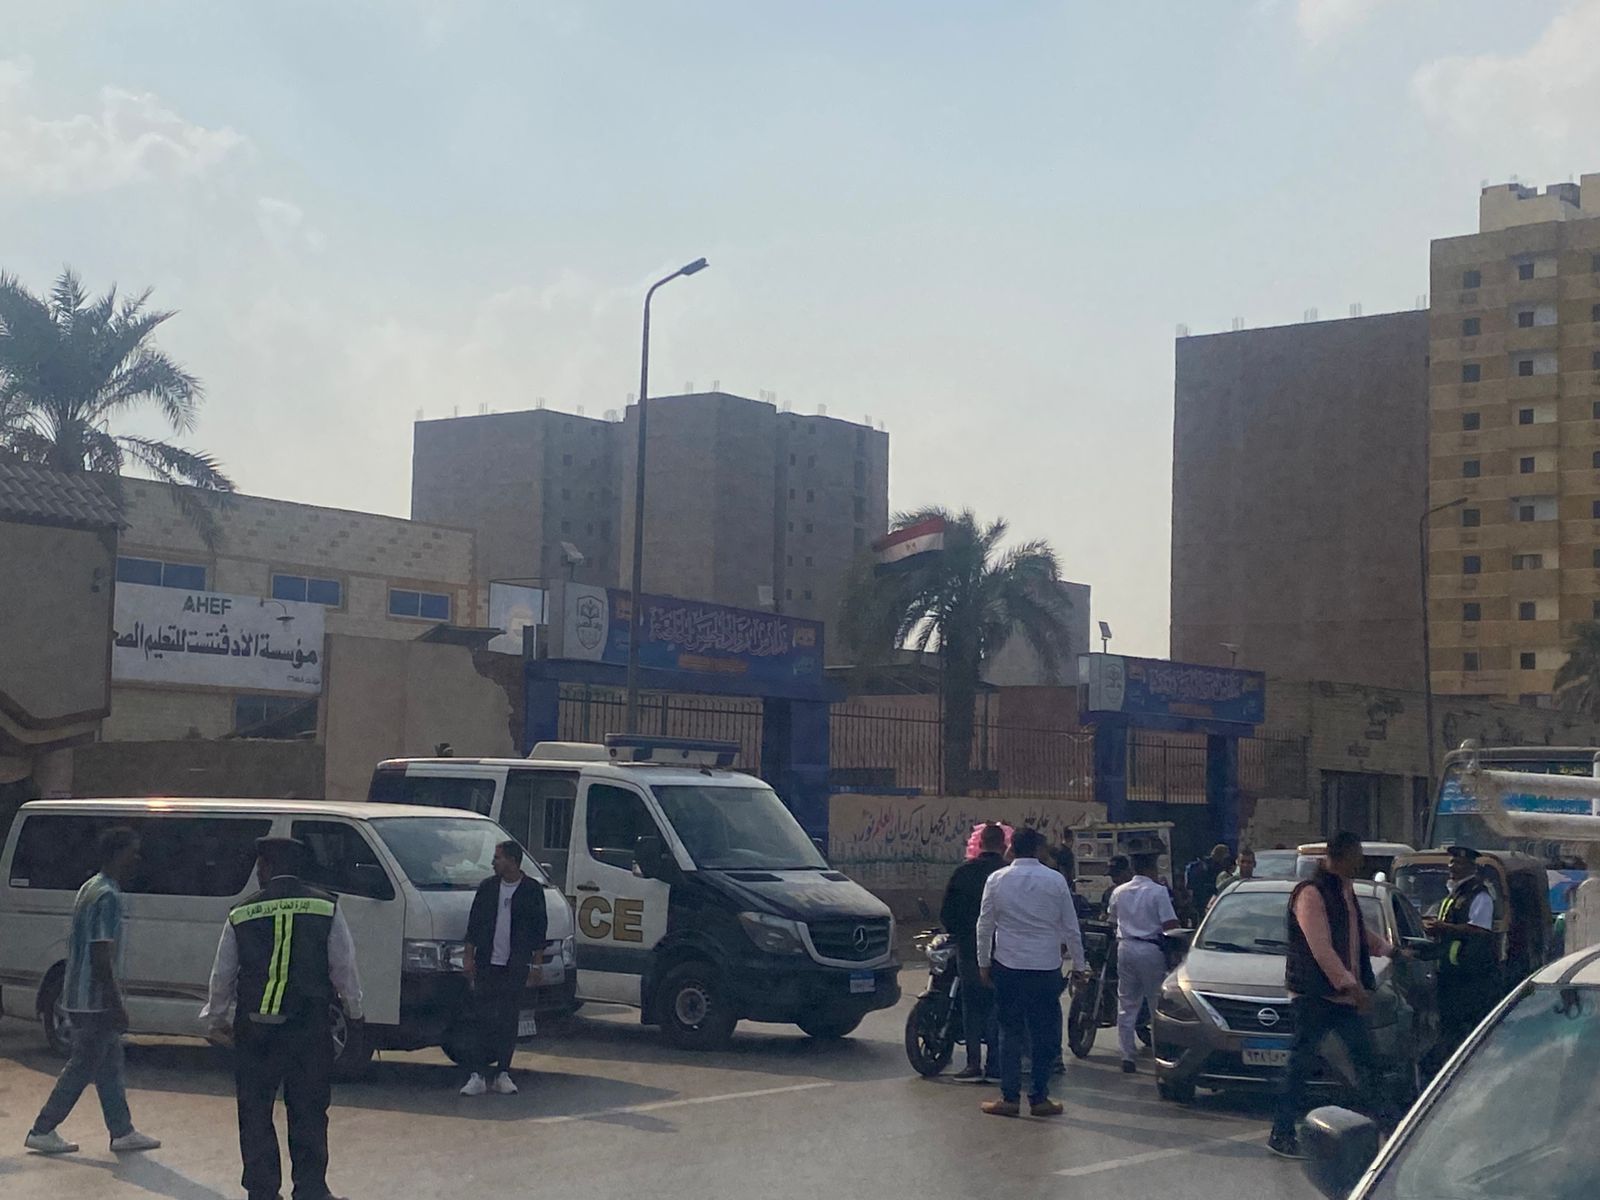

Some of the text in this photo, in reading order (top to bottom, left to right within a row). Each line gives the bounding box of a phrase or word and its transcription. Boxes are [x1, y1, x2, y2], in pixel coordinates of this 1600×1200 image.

[182, 595, 232, 615] AHEF
[144, 625, 187, 661] للتعليم
[259, 633, 319, 669] مؤسسة
[566, 895, 643, 942] CE
